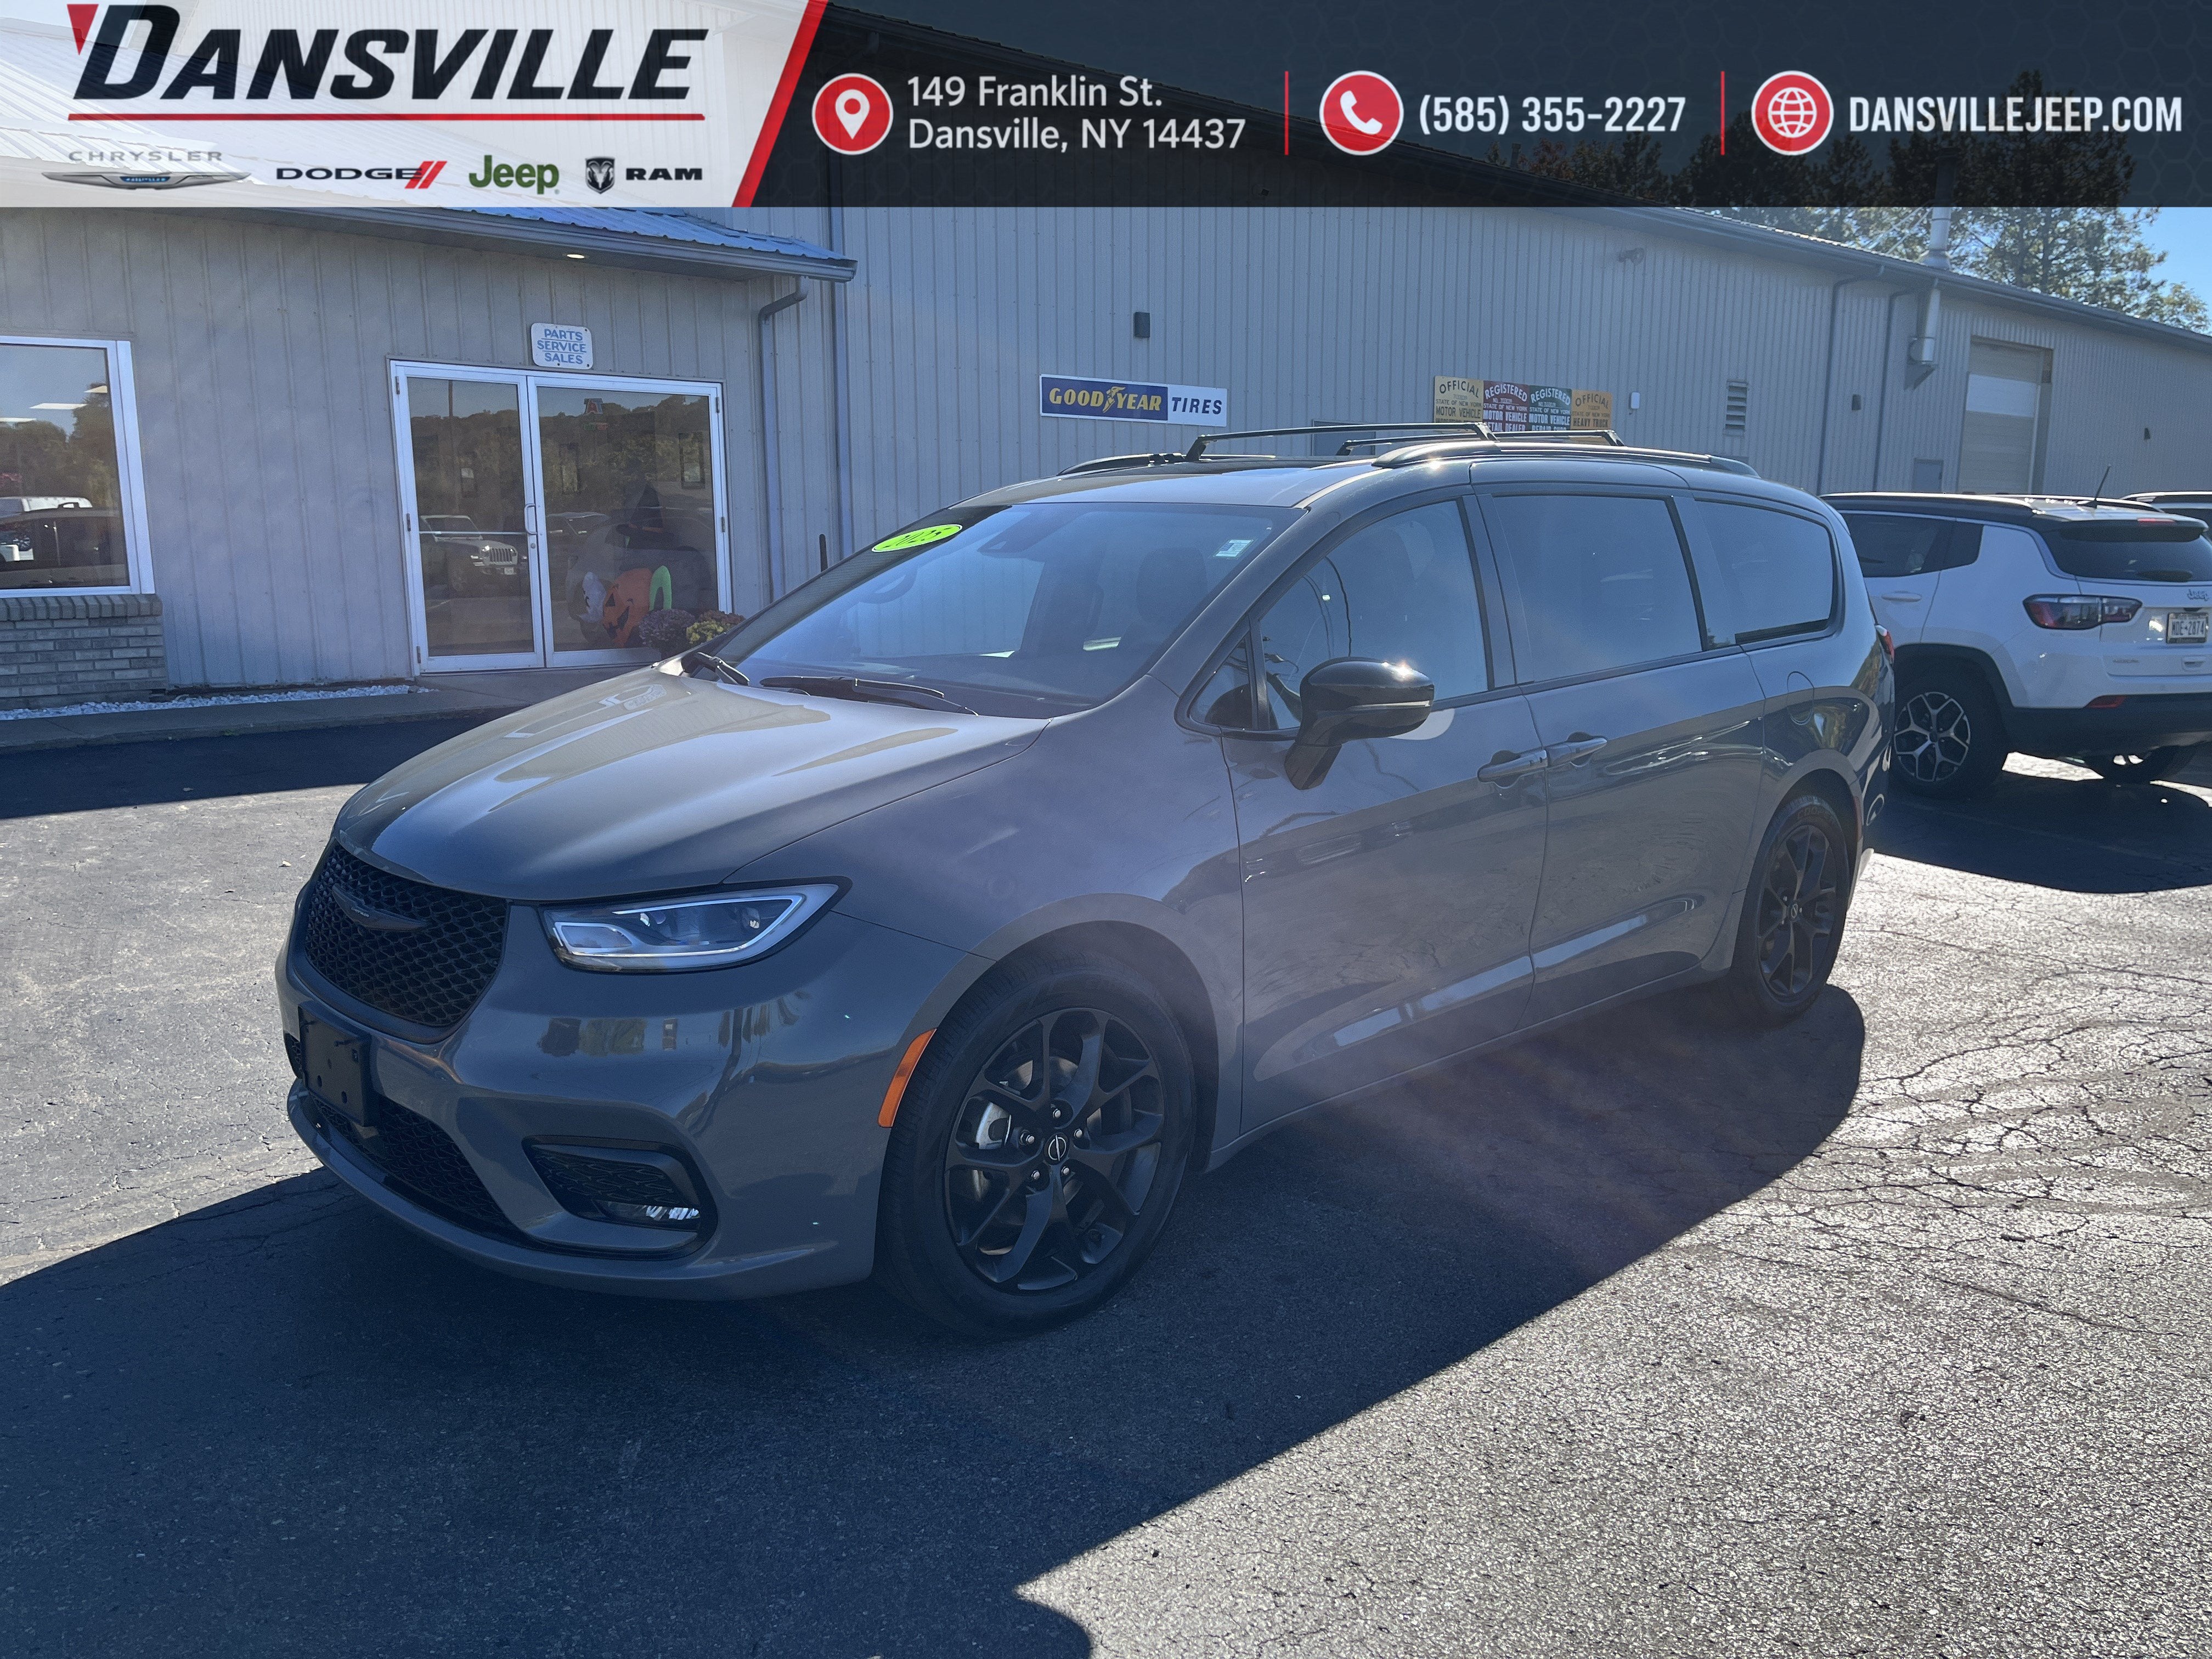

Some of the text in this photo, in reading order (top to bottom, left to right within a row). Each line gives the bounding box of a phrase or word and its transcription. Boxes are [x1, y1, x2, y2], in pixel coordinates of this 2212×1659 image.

[544, 329, 583, 341] PARTS
[537, 340, 586, 353] SERVICE
[545, 353, 583, 364] SALES
[1439, 380, 1479, 398] OFFICIAL
[1485, 383, 1527, 402] REGISTERED
[1048, 387, 1222, 415] GOODYEAR TIRES
[1531, 388, 1571, 405] REGISTERED
[1575, 393, 1609, 409] OFFICIAL
[1436, 406, 1481, 419] MOTOR VEHICLE
[1483, 410, 1503, 421] MOTOR
[1505, 411, 1527, 422] VEHICLE
[1528, 413, 1570, 426] MOTOR VEHICLE
[1573, 417, 1609, 427] HEAVY TRUCK
[1487, 422, 1526, 432] ETAIL DEALER
